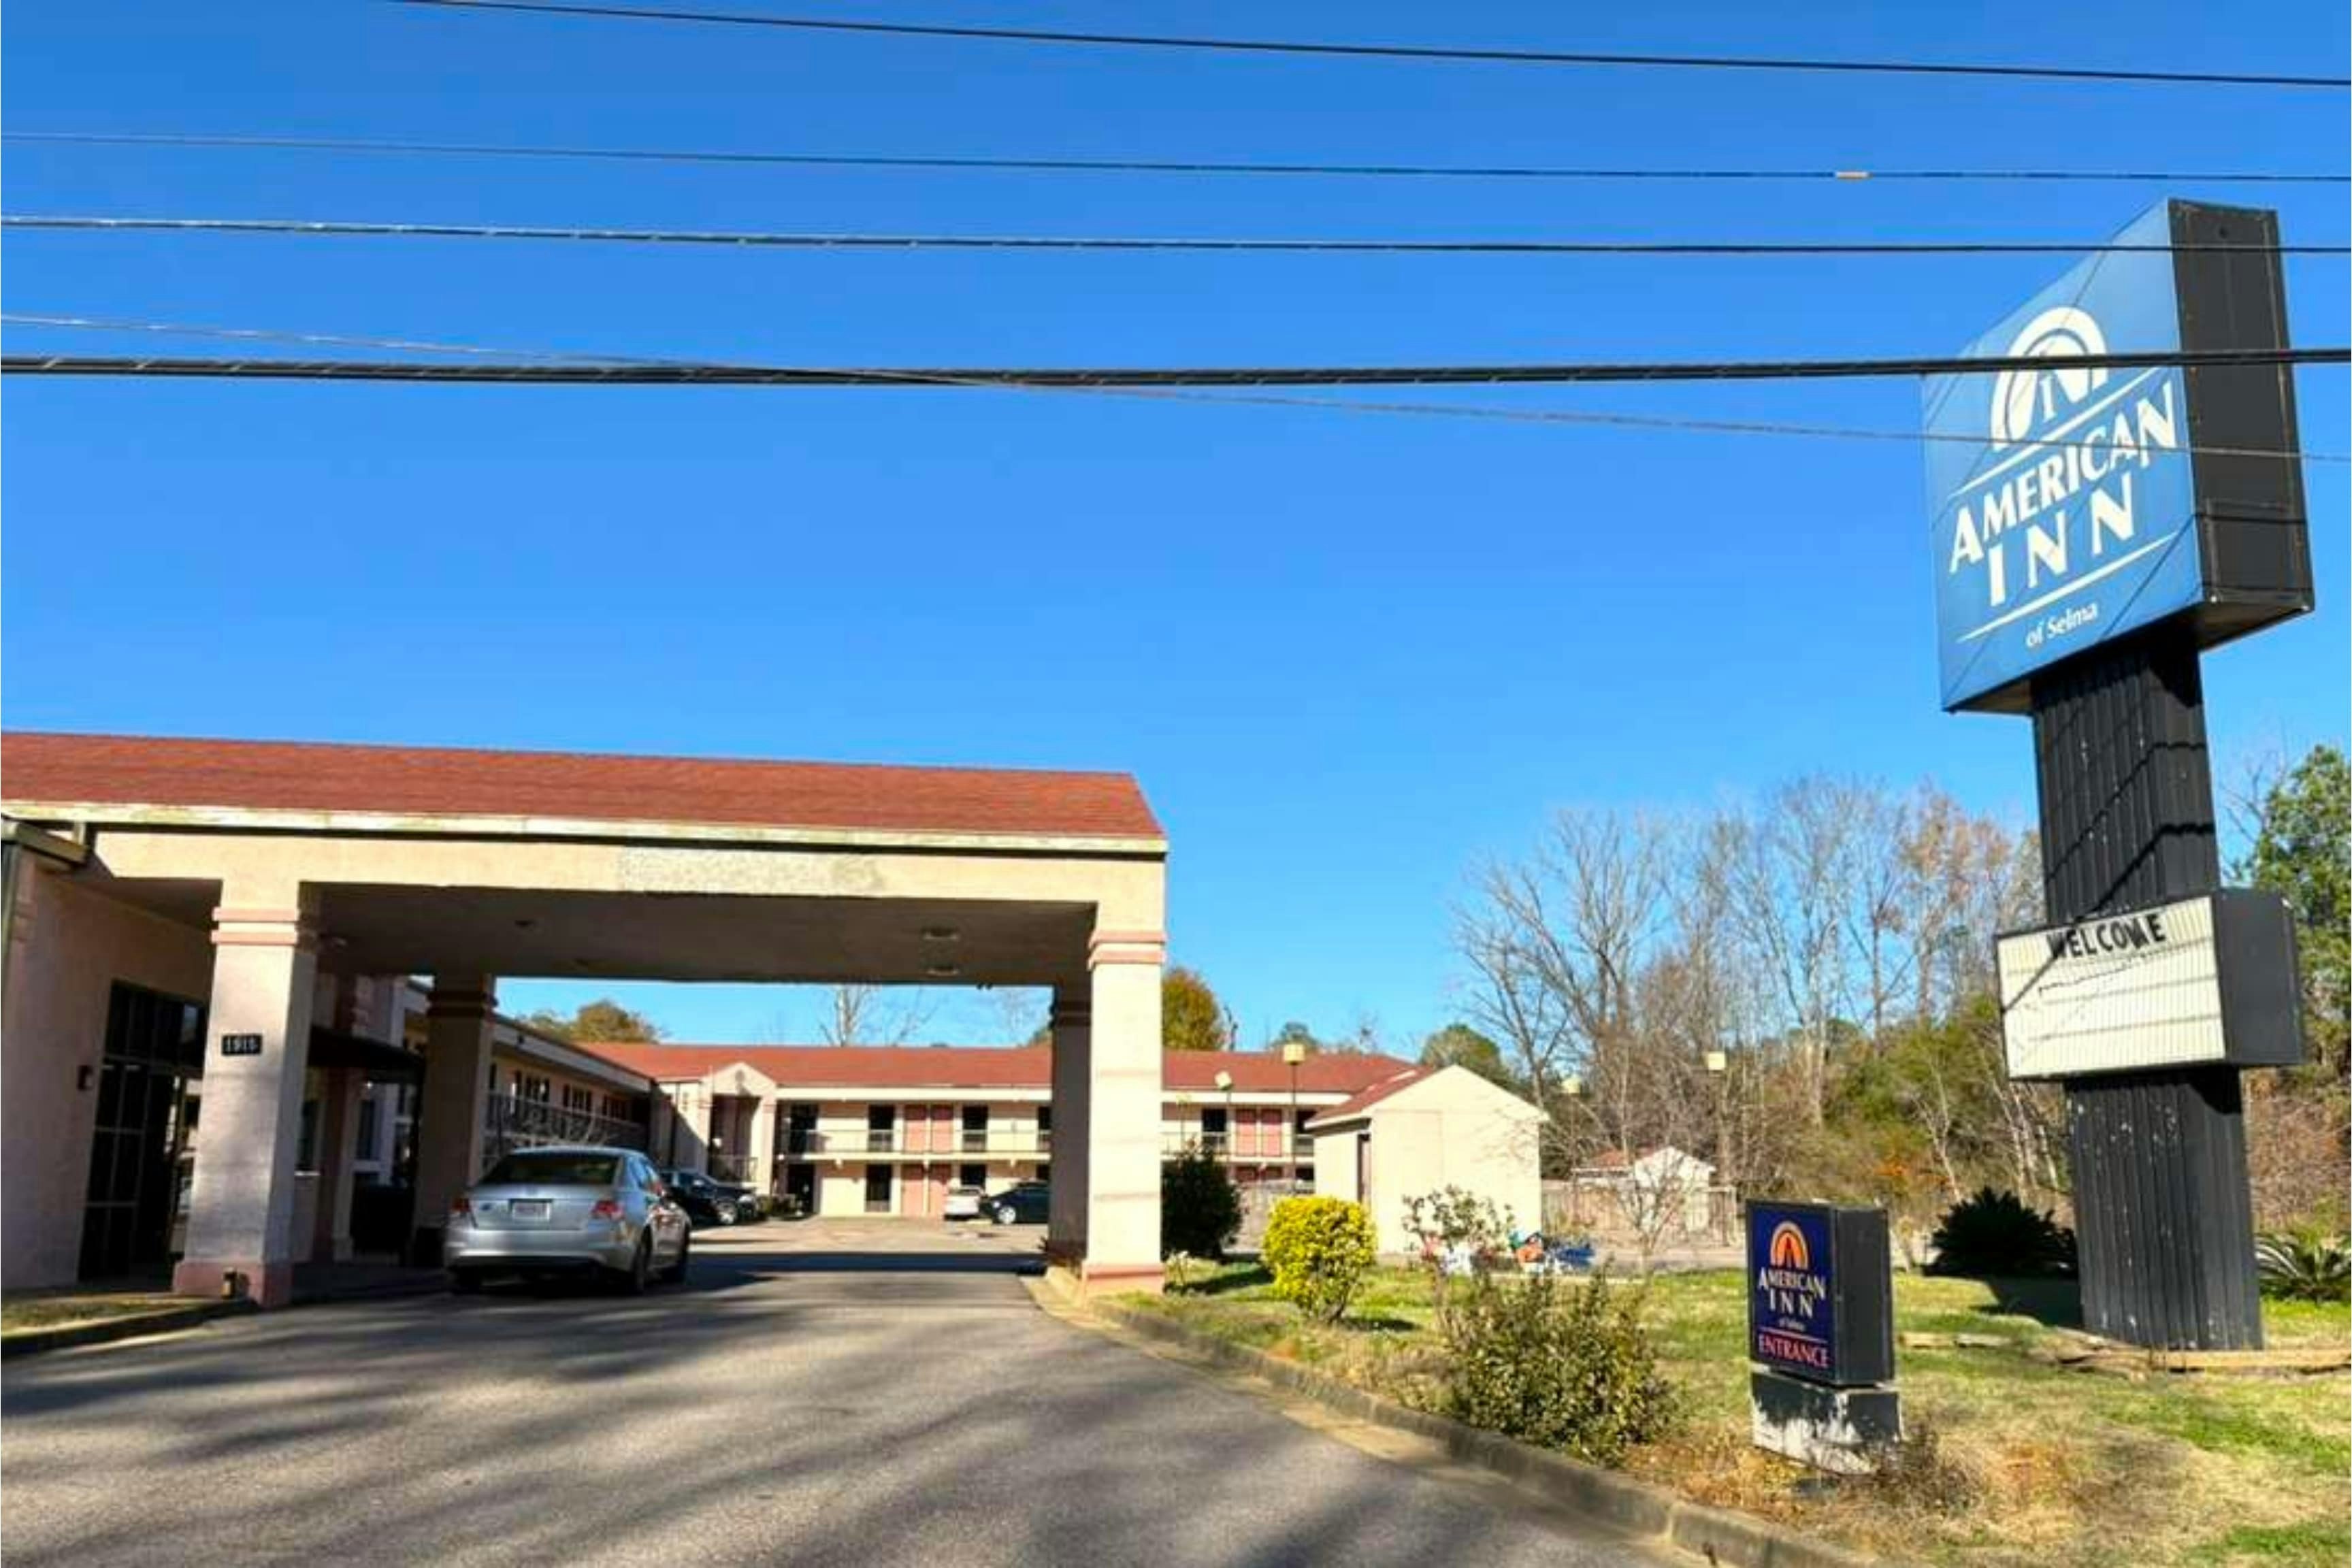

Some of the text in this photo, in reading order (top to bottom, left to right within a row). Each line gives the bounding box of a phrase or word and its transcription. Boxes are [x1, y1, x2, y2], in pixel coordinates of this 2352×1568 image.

[1949, 380, 2176, 574] AMERICAN
[1987, 472, 2135, 606] INN
[2025, 602, 2097, 647] of Selma
[2045, 913, 2166, 959] WELCOME
[1758, 1267, 1827, 1301] AMERICAN
[1769, 1288, 1813, 1319] INN
[1759, 1333, 1829, 1368] ENTRANCE
